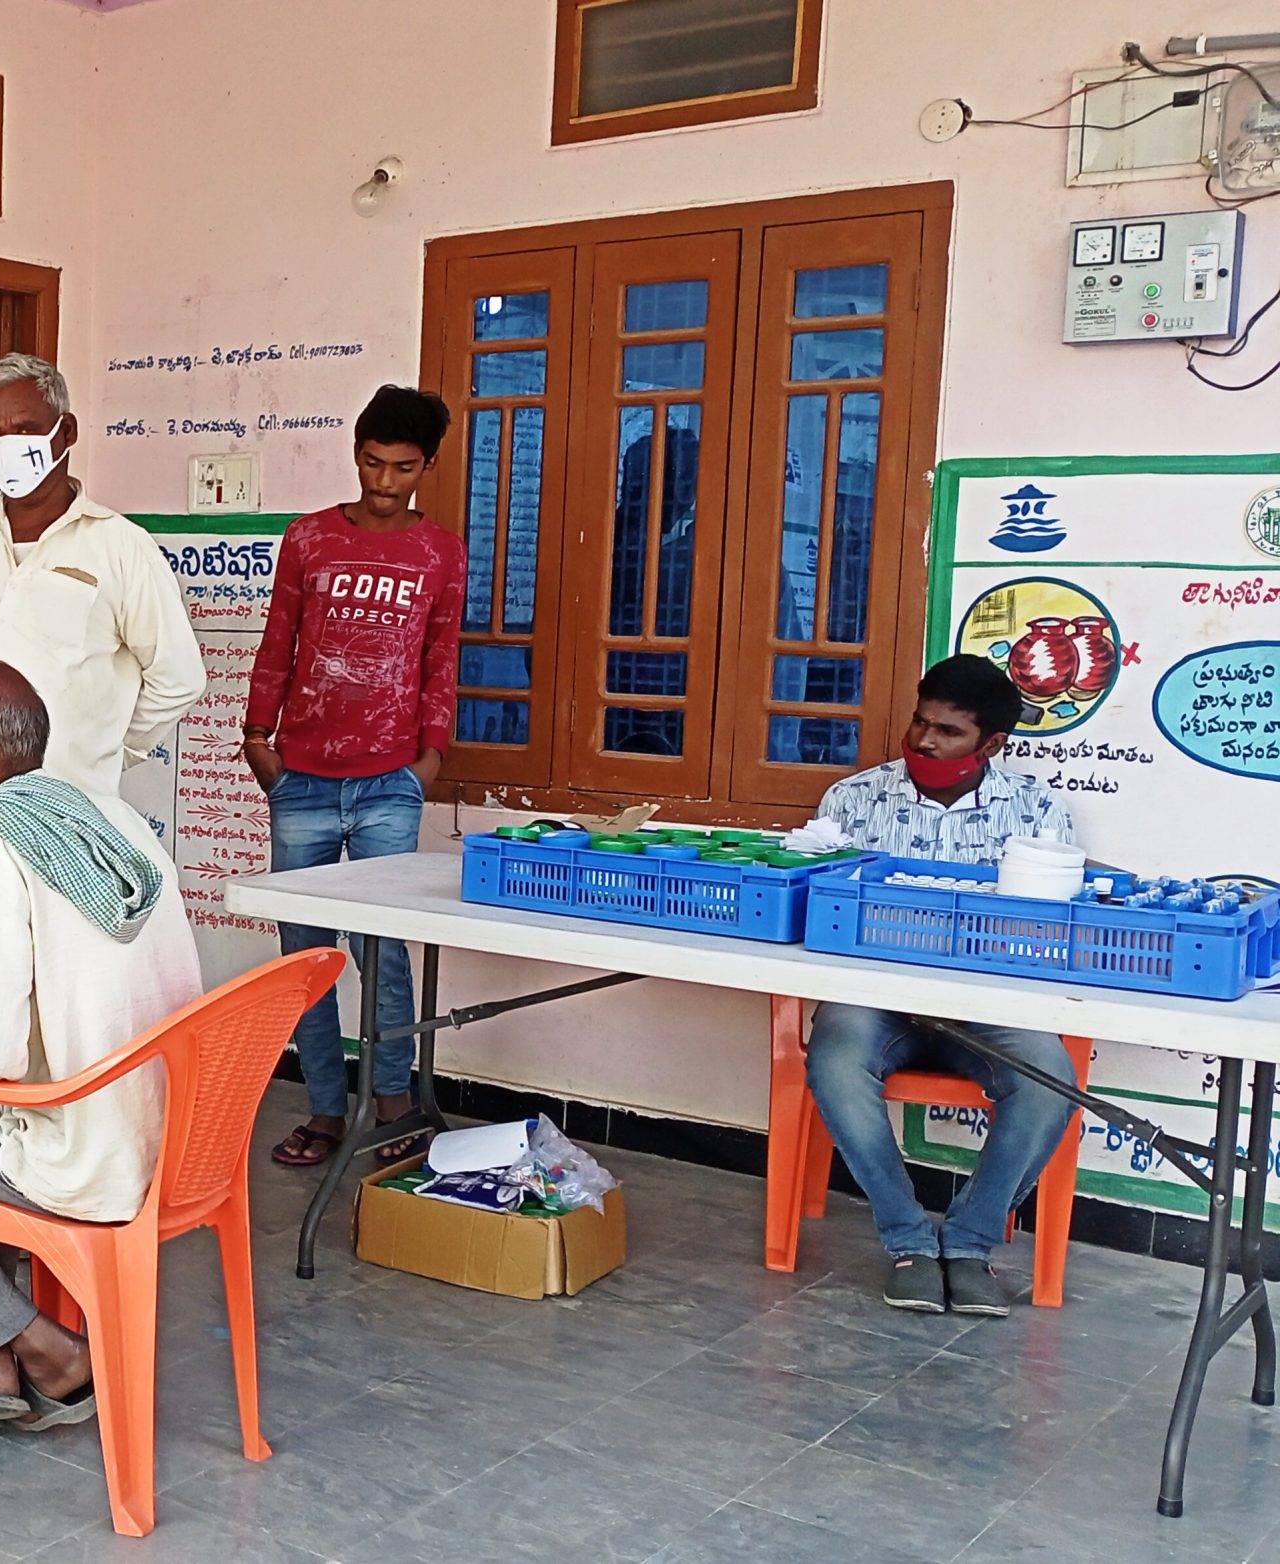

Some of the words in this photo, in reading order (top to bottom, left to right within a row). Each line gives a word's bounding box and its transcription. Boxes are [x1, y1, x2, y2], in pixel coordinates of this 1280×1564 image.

[326, 606, 408, 627] ASPECT
[1192, 659, 1276, 691] ప్రభుత్వం
[1240, 690, 1274, 715] నీటి
